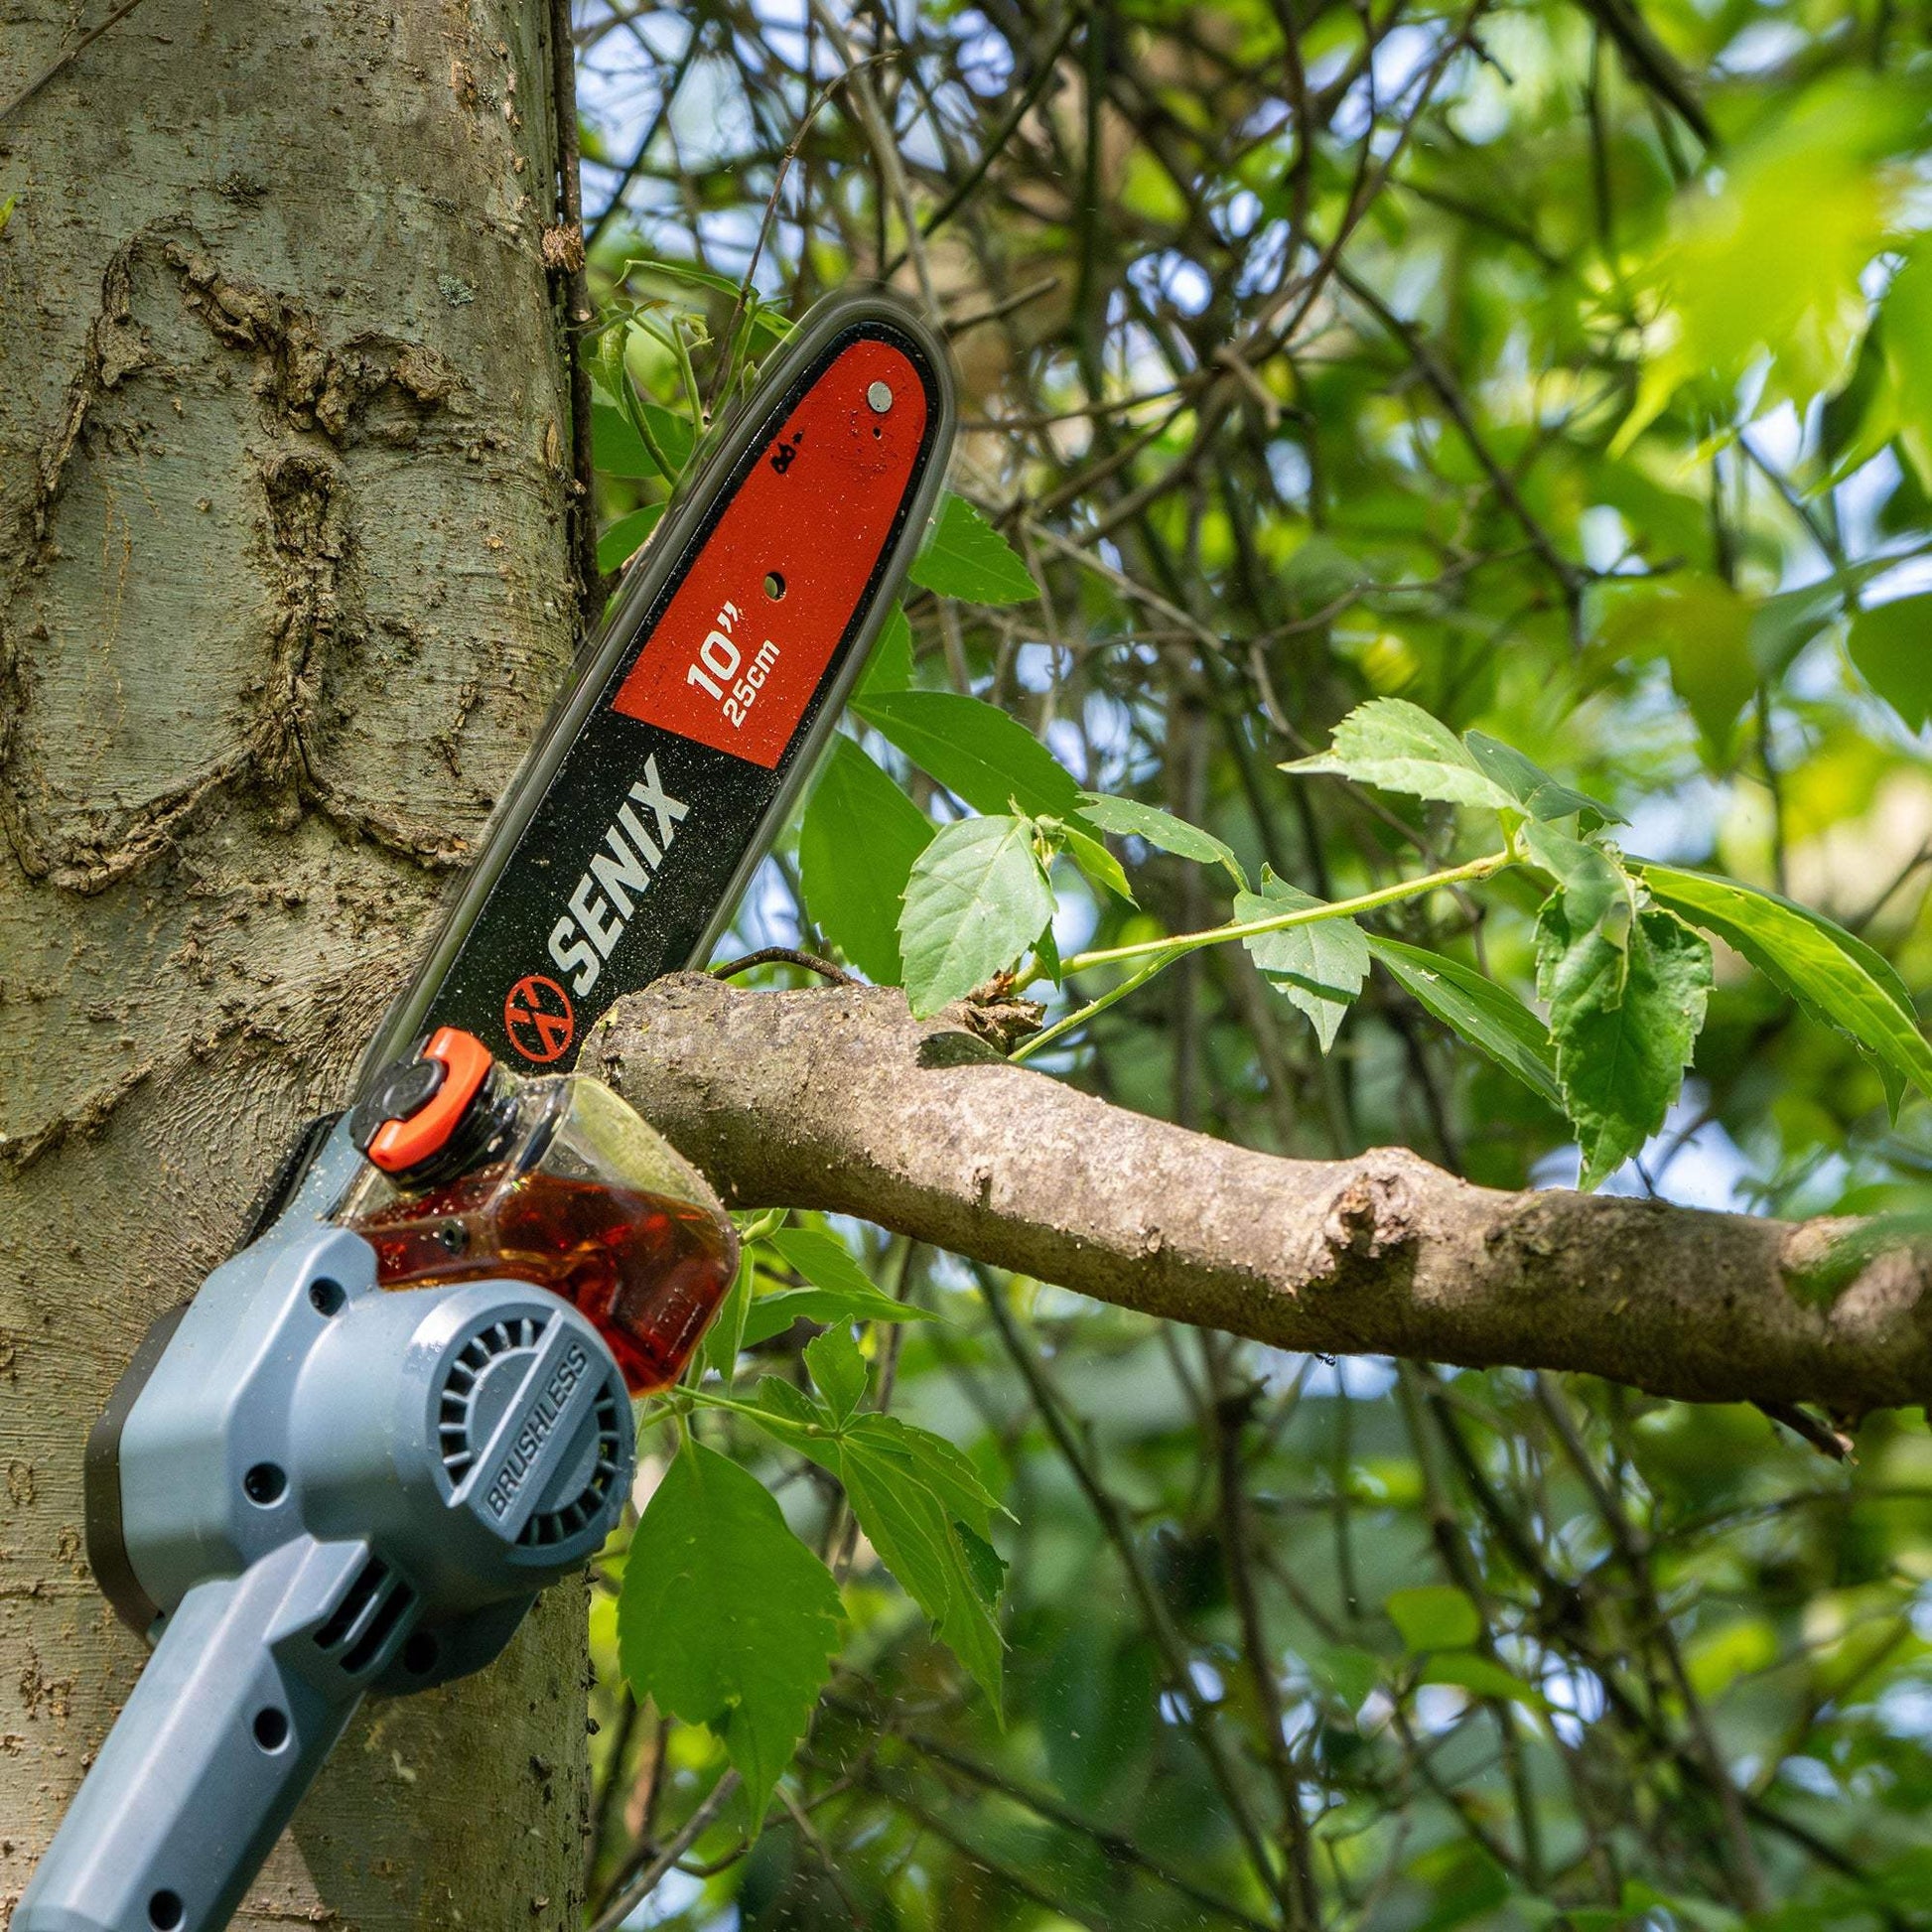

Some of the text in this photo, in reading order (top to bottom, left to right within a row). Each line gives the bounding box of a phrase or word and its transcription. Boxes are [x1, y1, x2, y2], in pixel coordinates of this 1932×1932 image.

[722, 638, 780, 729] 25cm
[548, 753, 690, 997] SENIX
[486, 1344, 588, 1519] BRUSHLESS
